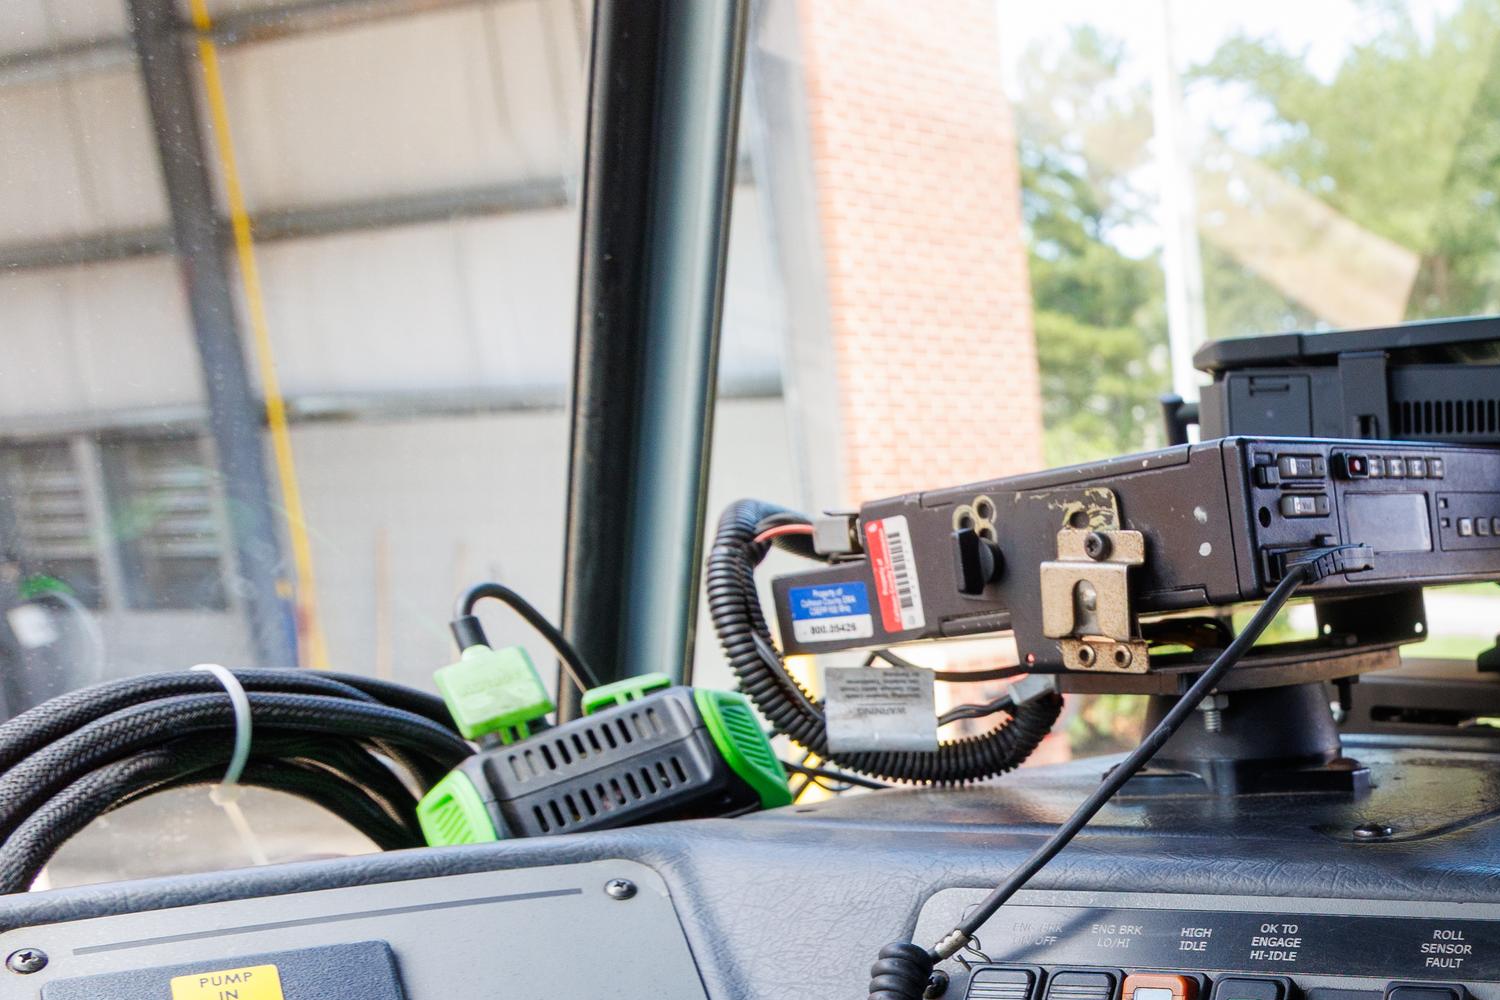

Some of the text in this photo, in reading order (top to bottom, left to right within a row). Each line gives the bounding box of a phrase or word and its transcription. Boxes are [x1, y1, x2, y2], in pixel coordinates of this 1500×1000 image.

[1092, 923, 1143, 936] ENG BRK
[1180, 927, 1213, 939] HIGH
[1260, 923, 1299, 935] OK TO
[1432, 929, 1465, 941] ROLL
[1097, 936, 1132, 949] LO/HI
[1178, 940, 1207, 951] IDLE
[1251, 936, 1302, 949] ENGAGE
[1420, 943, 1472, 955] SENSOR
[1249, 950, 1298, 962] HI-IDLE
[1425, 957, 1464, 969] FAULT
[199, 971, 253, 988] PUMP
